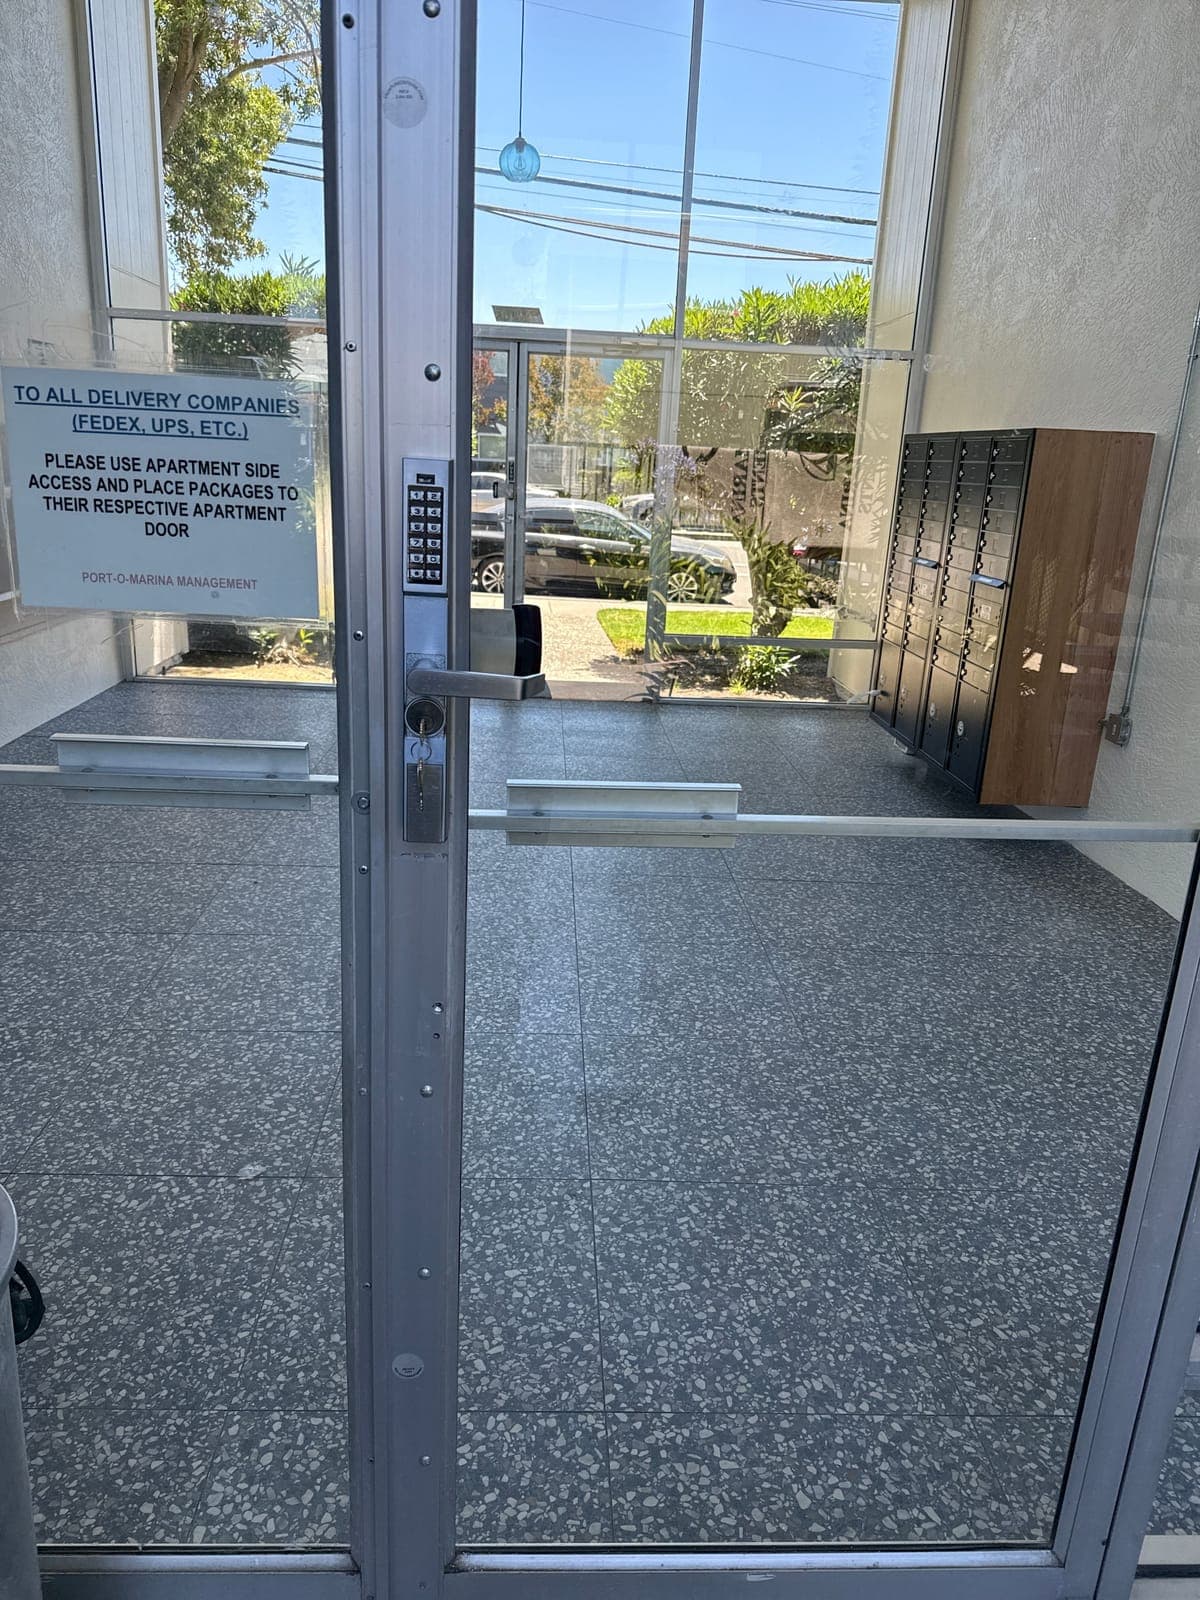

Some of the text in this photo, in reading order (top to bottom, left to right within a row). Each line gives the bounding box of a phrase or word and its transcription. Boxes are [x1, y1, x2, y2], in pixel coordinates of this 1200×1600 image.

[14, 385, 300, 414] TO ALL DELIVERY COMPANIES
[72, 413, 249, 440] (FEDEX, UPS, ETC.)
[45, 453, 281, 478] PLEASE USE APARTMENT SIDE
[28, 474, 299, 501] ACCESS AND PLACE PACKAGES TO
[42, 496, 287, 522] THEIR RESPECTIVE APARTMENT
[144, 522, 190, 538] DOOR
[81, 571, 258, 590] PORT-O-MARINA MANAGEMENT
